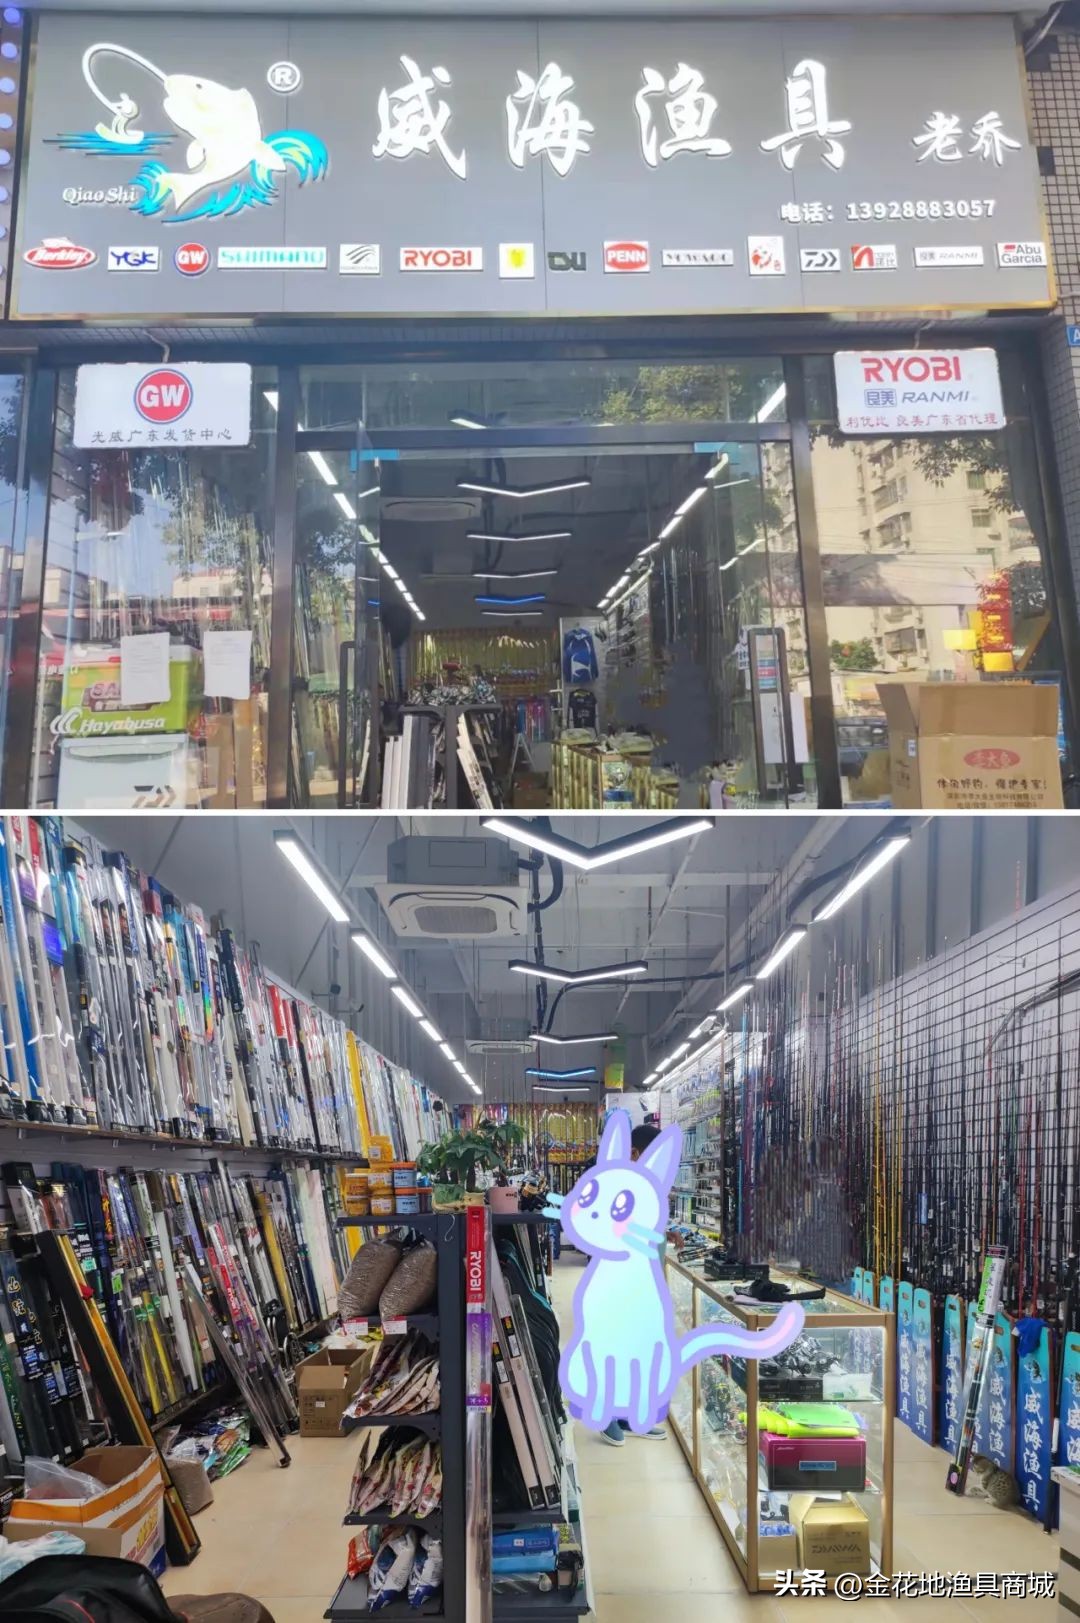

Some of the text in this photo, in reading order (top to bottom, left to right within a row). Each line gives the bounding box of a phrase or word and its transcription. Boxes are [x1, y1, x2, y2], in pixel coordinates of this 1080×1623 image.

[372, 54, 852, 180] 威海渔具
[911, 110, 1021, 166] 老乔
[177, 250, 207, 265] GW
[404, 249, 473, 266] RYOBI
[607, 251, 647, 263] PENN
[1001, 254, 1043, 264] Garcia
[1016, 244, 1042, 254] Abu
[860, 356, 962, 382] RYOBI
[140, 383, 186, 408] GW
[901, 391, 970, 403] RANMI
[470, 1251, 482, 1291] RYOBI
[988, 1373, 1006, 1470] 威海渔
[1023, 1386, 1043, 1511] 威海渔具
